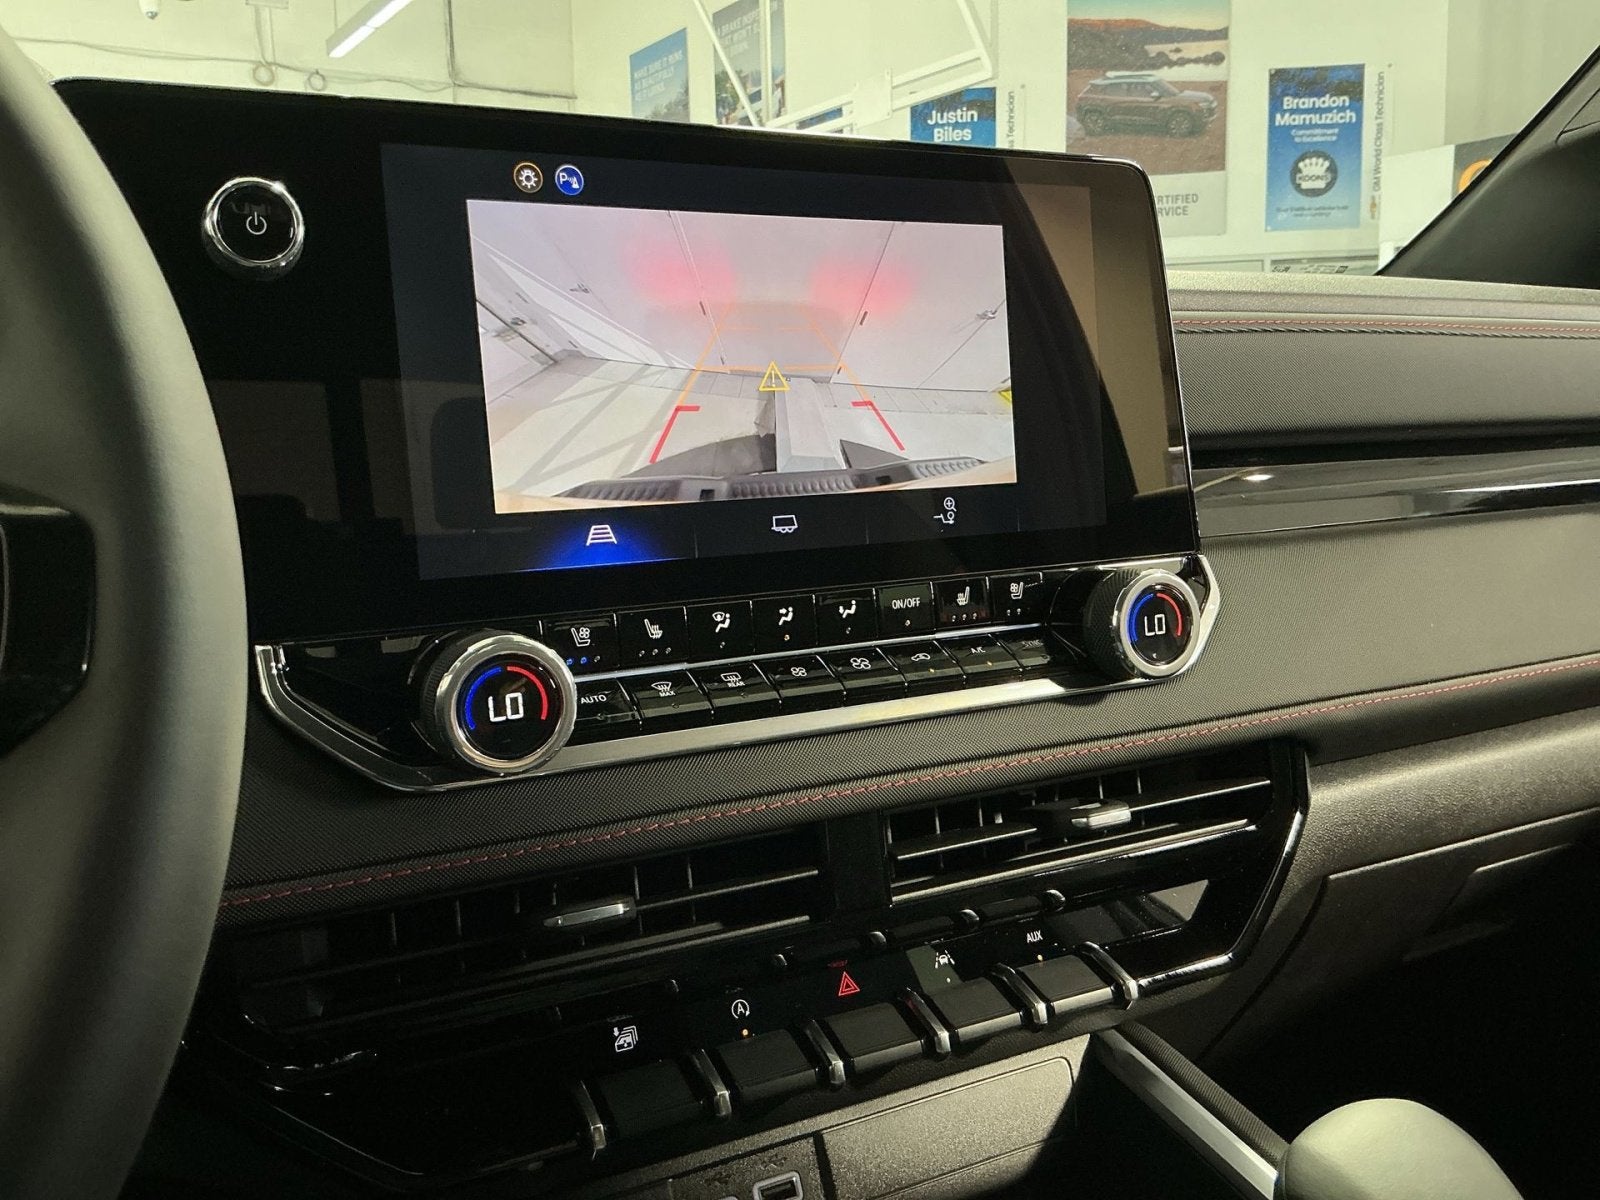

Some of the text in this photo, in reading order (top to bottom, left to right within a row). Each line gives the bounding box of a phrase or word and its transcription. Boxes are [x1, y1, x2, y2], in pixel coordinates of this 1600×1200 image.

[1283, 93, 1350, 110] Brandon
[1375, 71, 1384, 120] Technician
[927, 107, 978, 125] Justin
[1006, 91, 1015, 140] Technician
[934, 127, 972, 142] Biles
[1374, 122, 1383, 147] Class
[1374, 148, 1382, 175] World
[1157, 193, 1199, 205] RTIFIED
[1157, 205, 1189, 217] RVICE
[892, 597, 921, 610] ON/OFF
[1144, 613, 1166, 637] LO
[970, 645, 986, 654] A/C
[727, 680, 745, 688] REAR
[580, 694, 608, 704] AUTO
[488, 692, 524, 723] LO
[1026, 929, 1044, 944] AUX
